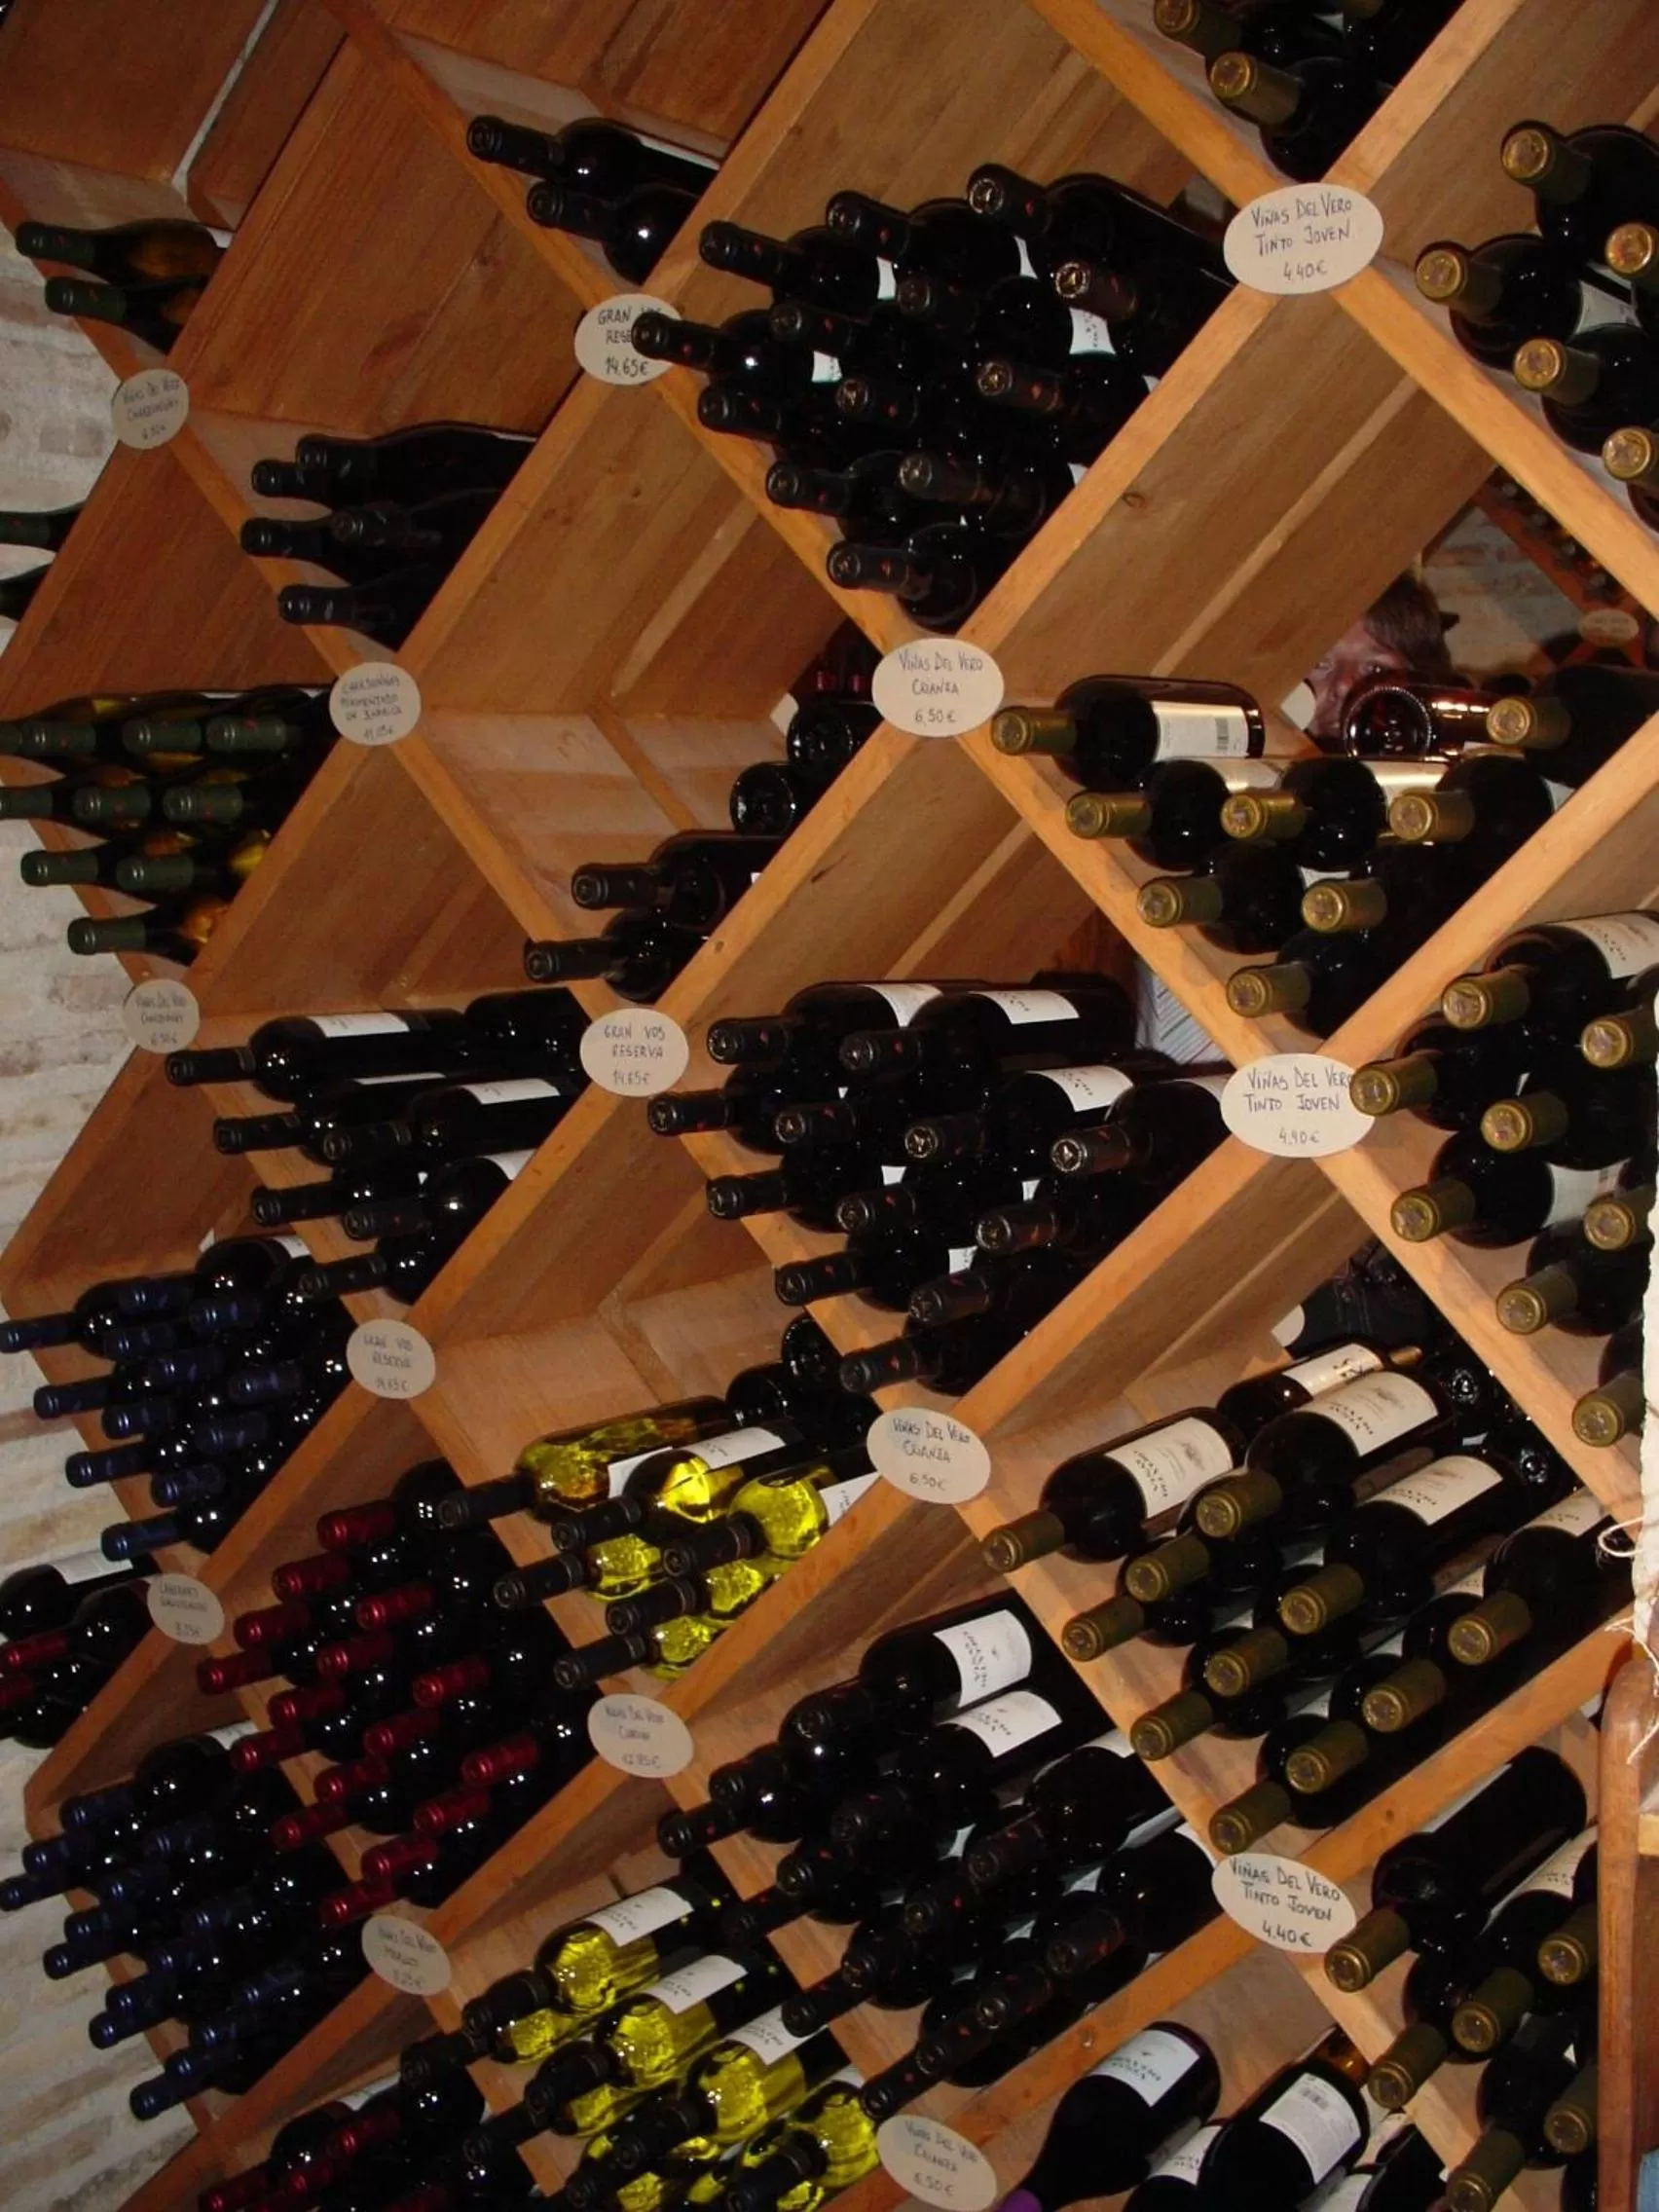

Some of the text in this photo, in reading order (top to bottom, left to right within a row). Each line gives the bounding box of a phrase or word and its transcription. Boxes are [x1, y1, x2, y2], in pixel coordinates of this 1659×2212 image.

[1255, 218, 1351, 256] TINTO JOVEN
[598, 306, 632, 325] GRAN
[958, 651, 983, 671] VERO
[604, 1022, 665, 1041] GRAN VOS
[612, 1044, 663, 1058] RESERVA
[1247, 1067, 1289, 1090] VIÑAS
[1294, 1067, 1318, 1088] DEL
[1244, 1093, 1340, 1113] TINTO JOVEN
[1230, 1858, 1341, 1901] VIÑAS DEL VERO
[1240, 1880, 1332, 1921] TINTO JOVEN
